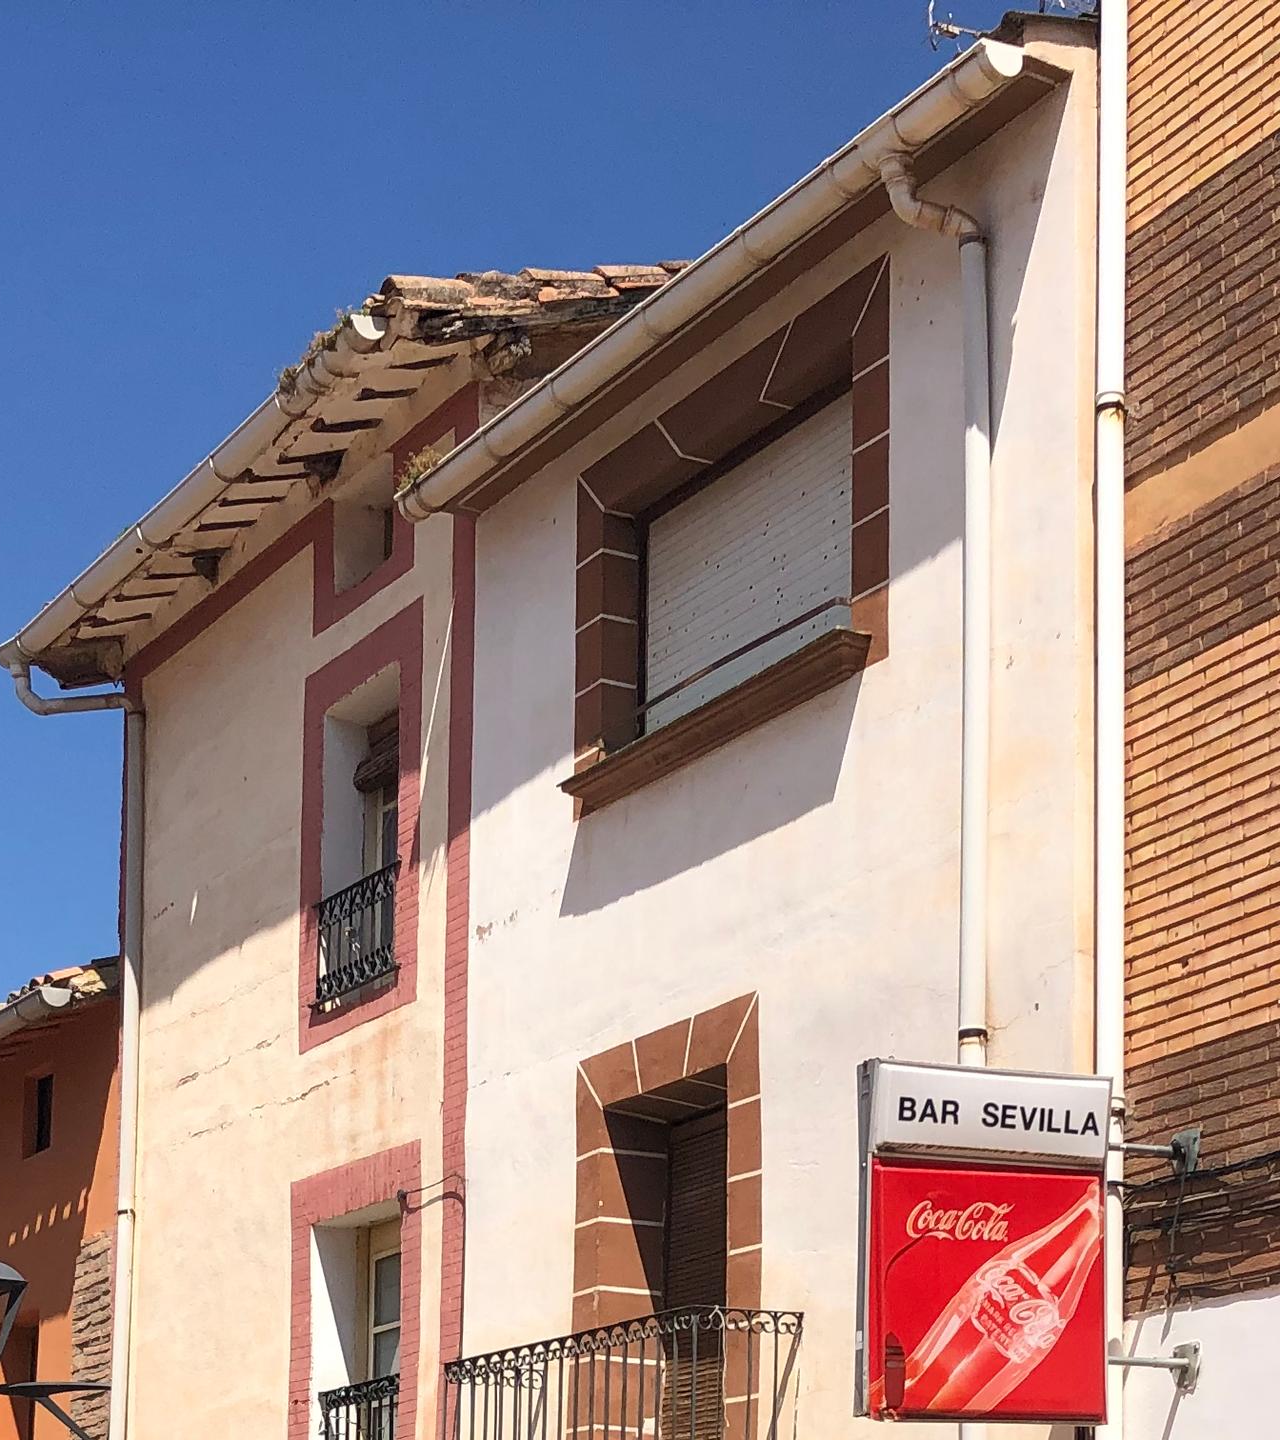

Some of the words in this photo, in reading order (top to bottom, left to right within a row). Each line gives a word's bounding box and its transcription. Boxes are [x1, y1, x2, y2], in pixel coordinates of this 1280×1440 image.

[898, 1096, 960, 1125] BAR
[981, 1102, 1100, 1136] SEVILLA
[906, 1200, 1015, 1241] Coca-Cola
